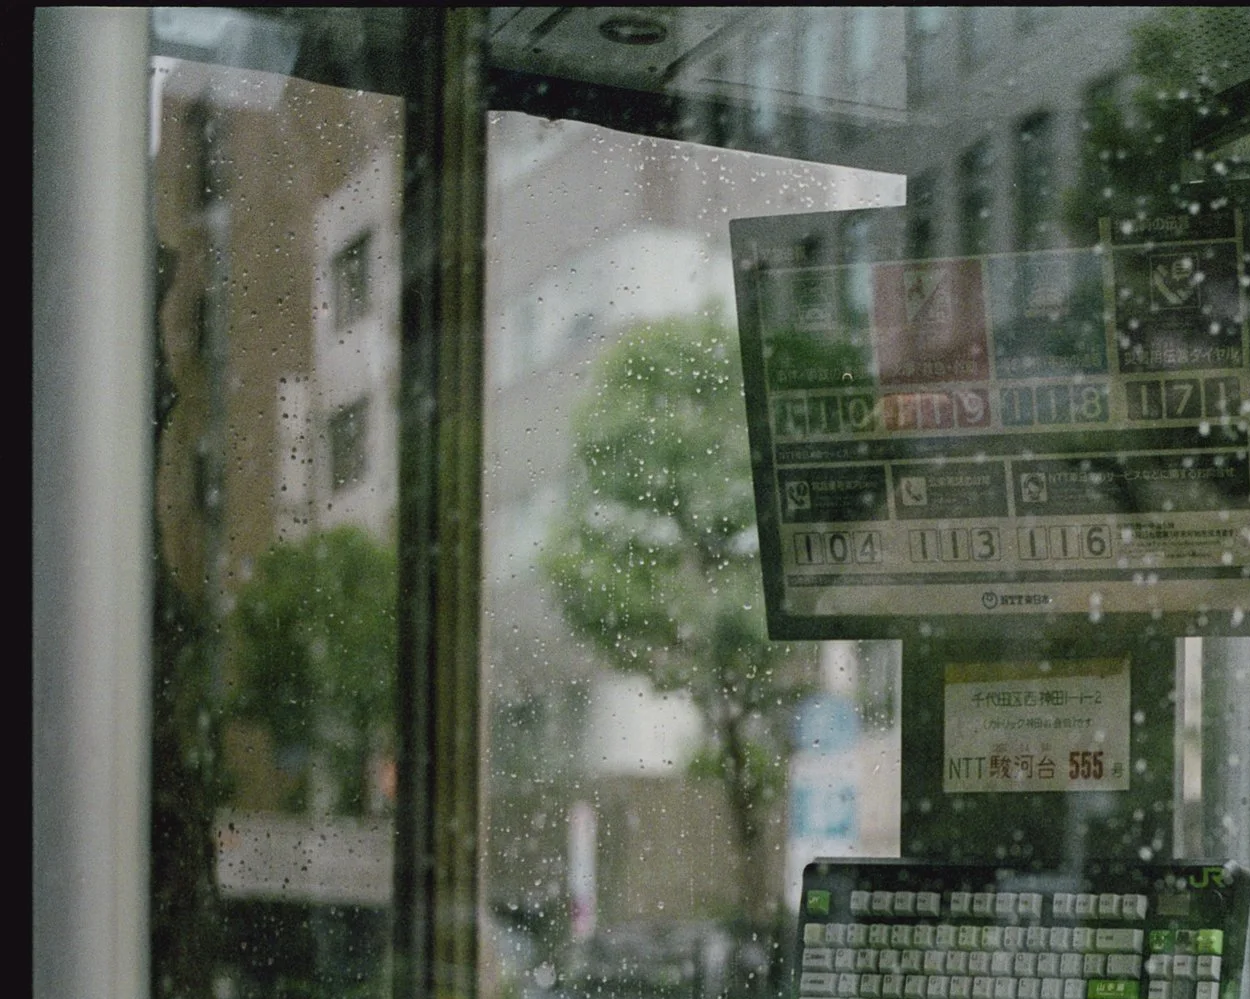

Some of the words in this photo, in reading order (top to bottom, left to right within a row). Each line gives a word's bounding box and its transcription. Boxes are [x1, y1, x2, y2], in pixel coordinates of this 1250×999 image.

[803, 532, 879, 563] 104
[919, 530, 995, 560] 113
[1028, 525, 1107, 558] 116
[1068, 749, 1105, 780] 555
[1189, 866, 1226, 889] JR
